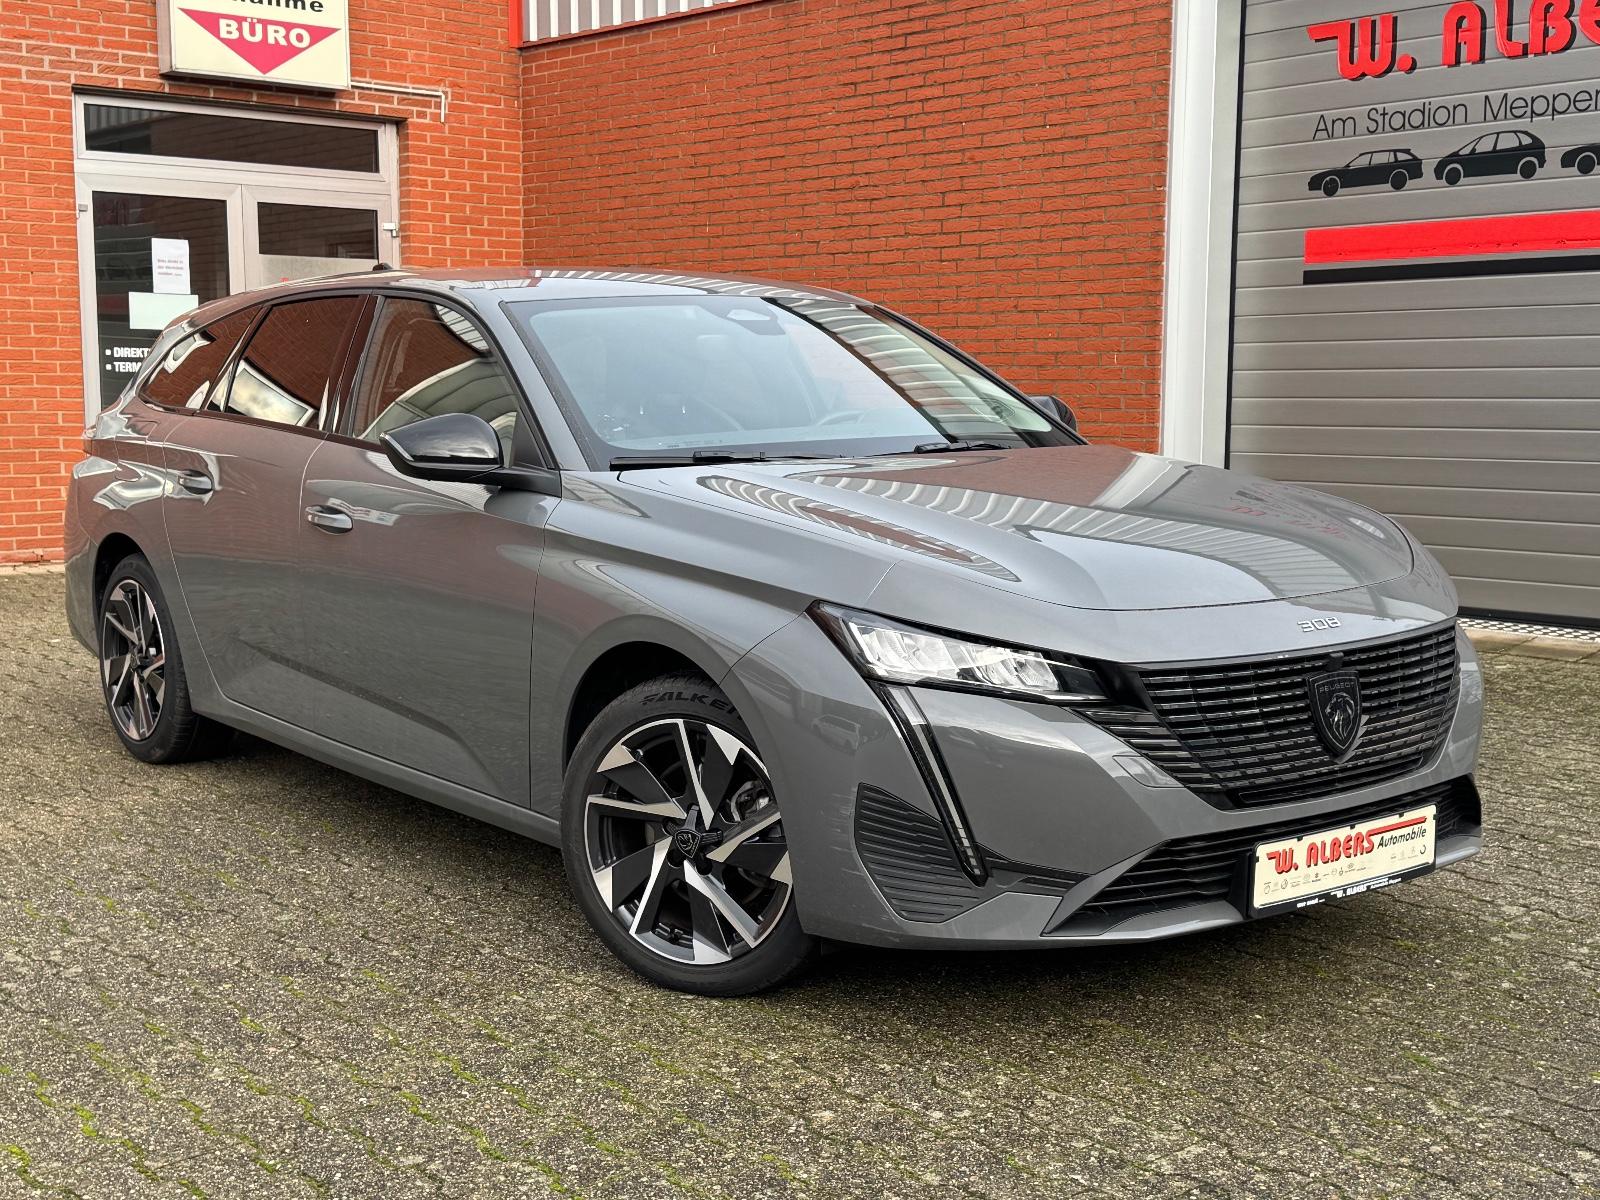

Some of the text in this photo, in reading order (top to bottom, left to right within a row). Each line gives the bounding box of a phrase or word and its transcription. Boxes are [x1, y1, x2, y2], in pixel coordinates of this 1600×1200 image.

[218, 17, 311, 49] BÜRO
[1306, 12, 1417, 81] W.
[1312, 114, 1357, 140] Am
[1366, 101, 1468, 134] Stadion
[113, 346, 151, 358] DIREKT
[1297, 616, 1342, 633] 308
[1266, 847, 1299, 875] W.
[1305, 829, 1375, 868] ALBERS
[1377, 825, 1427, 850] Automobile
